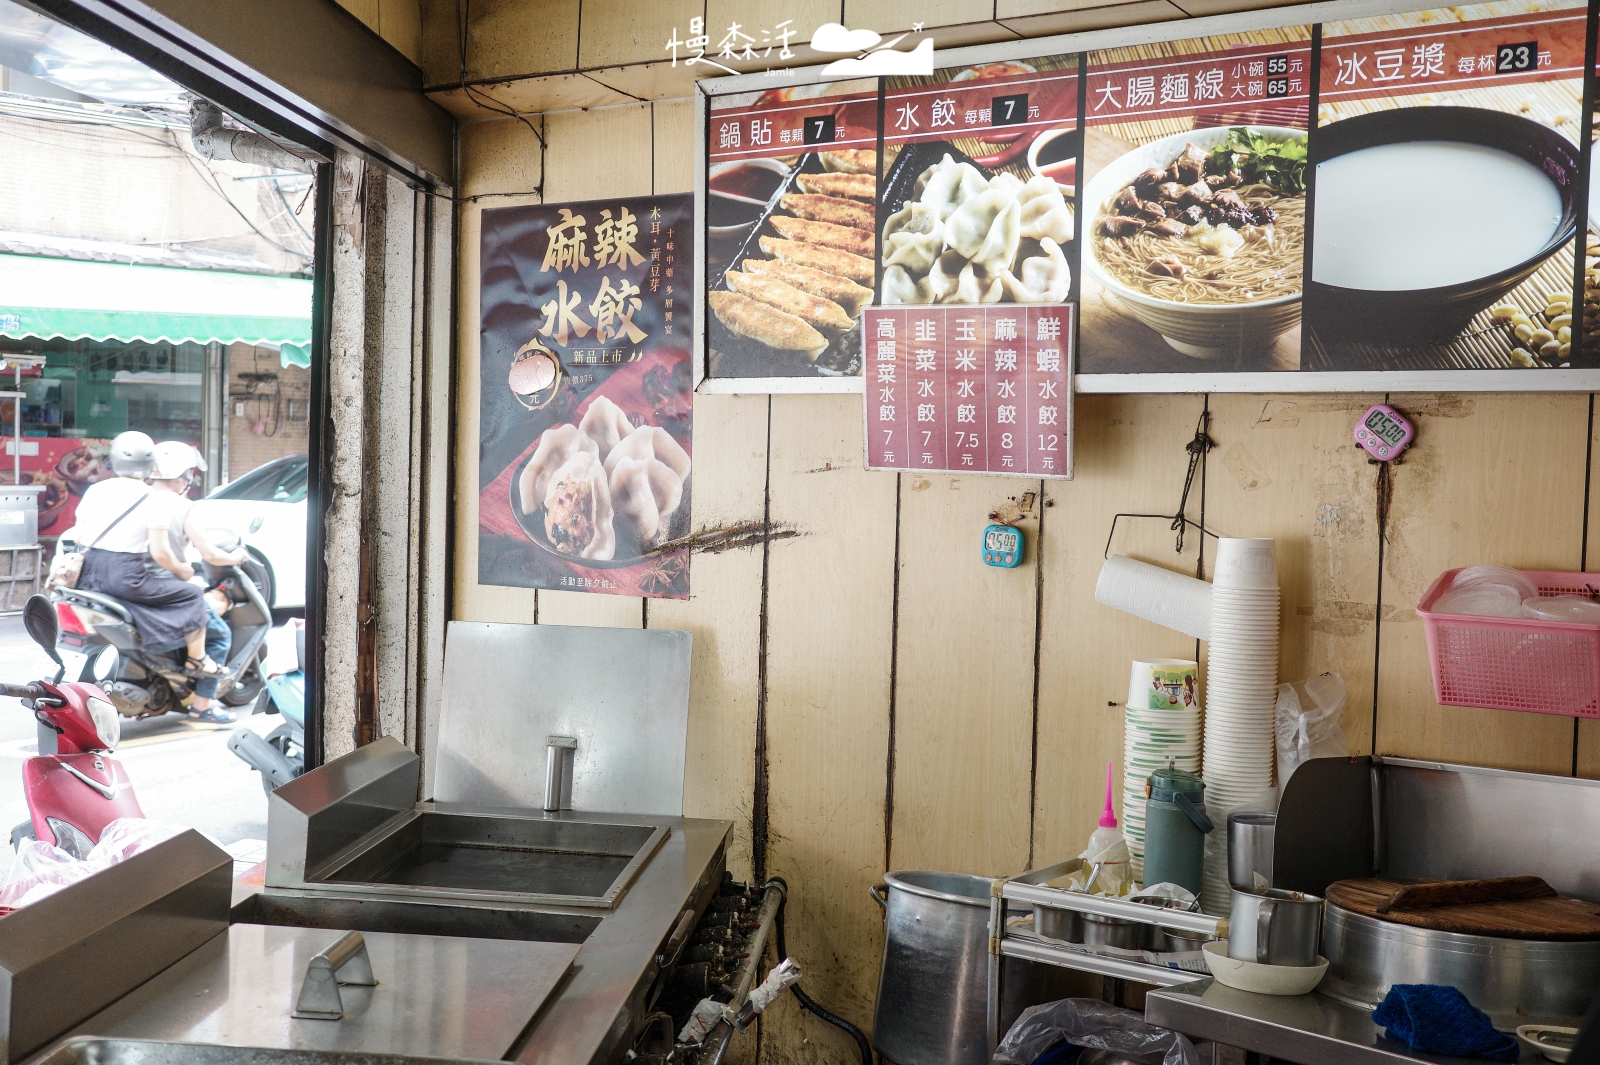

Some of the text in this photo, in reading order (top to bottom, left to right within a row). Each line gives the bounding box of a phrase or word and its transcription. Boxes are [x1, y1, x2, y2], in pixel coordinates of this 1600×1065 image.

[1334, 42, 1446, 87] 冰豆漿
[1094, 69, 1225, 112] 大腸麵線
[719, 118, 773, 148] 鍋貼
[895, 98, 956, 131] 水餃
[539, 206, 647, 274] 麻辣
[537, 275, 649, 347] 水餃
[573, 349, 622, 364] 新品上市
